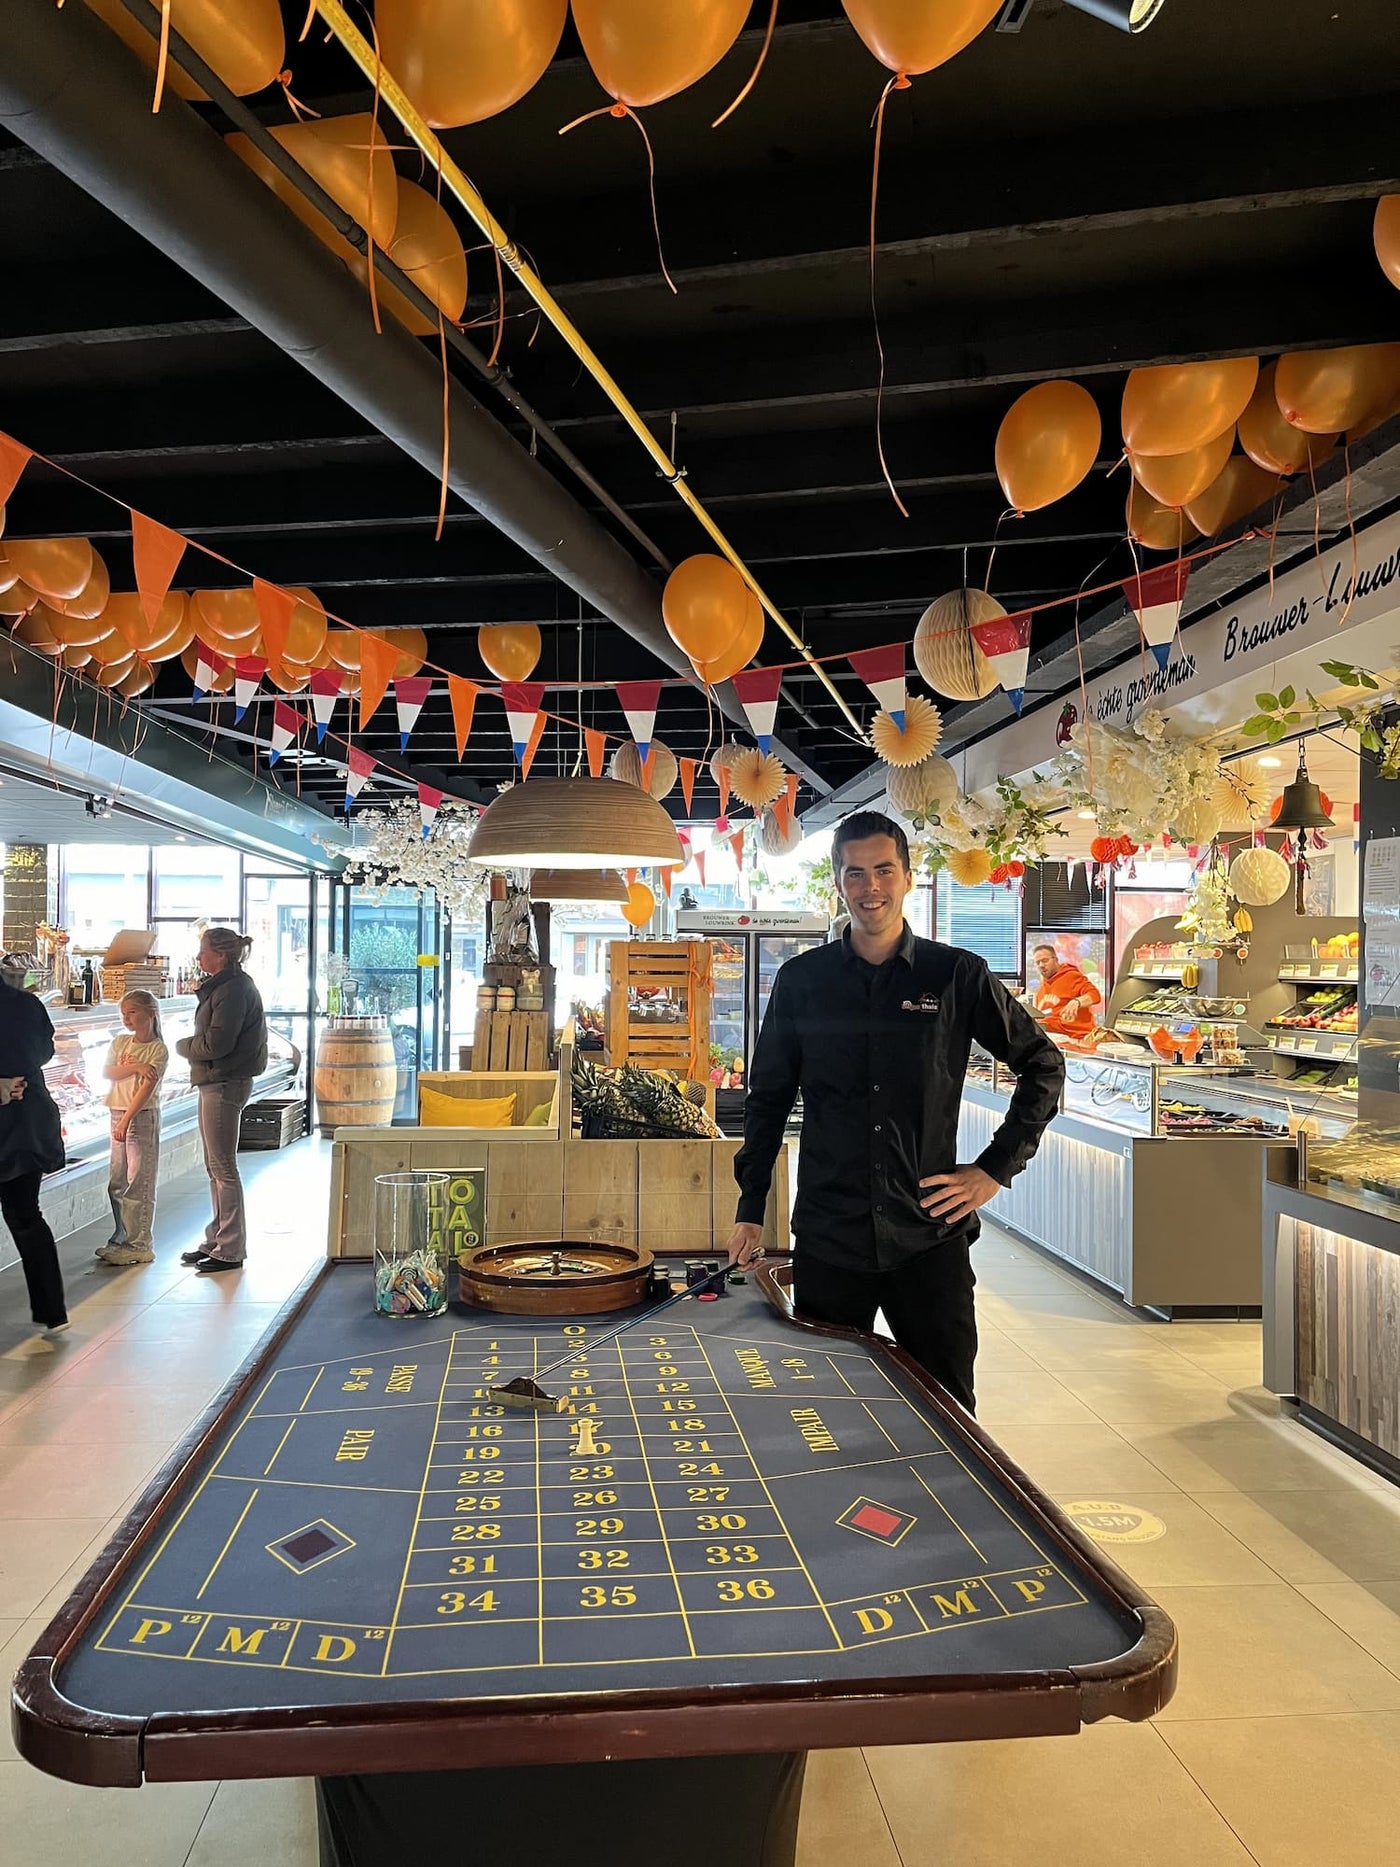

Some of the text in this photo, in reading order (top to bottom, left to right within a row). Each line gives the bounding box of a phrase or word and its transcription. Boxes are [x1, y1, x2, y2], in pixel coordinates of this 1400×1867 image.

[563, 1326, 586, 1336] 0
[488, 1341, 499, 1350] 1
[568, 1340, 586, 1348] 2
[649, 1337, 668, 1346] 3
[482, 1356, 502, 1365] 4
[654, 1351, 673, 1360] 6
[481, 1371, 500, 1380] 7
[570, 1368, 590, 1379] 8
[658, 1366, 678, 1376] 9
[734, 1348, 777, 1389] MANQUE
[780, 1358, 816, 1380] 1-18
[341, 1367, 374, 1391] 19-36
[384, 1364, 418, 1393] PASSE
[568, 1385, 596, 1396] 11
[656, 1382, 690, 1393] 12
[469, 1406, 505, 1417] 13
[567, 1403, 601, 1414] 14
[661, 1399, 697, 1412] 15
[466, 1425, 503, 1438] 16
[667, 1418, 707, 1432] 18
[790, 1407, 840, 1454] IMPAIR
[334, 1429, 375, 1461] PAIR
[463, 1446, 501, 1460] 19
[672, 1439, 714, 1453] 21
[457, 1469, 505, 1485] 22
[569, 1465, 615, 1481] 23
[677, 1462, 724, 1477] 24
[572, 1490, 618, 1508] 26
[686, 1486, 730, 1502] 27
[455, 1495, 501, 1512] 25
[575, 1518, 625, 1536] 29
[695, 1514, 747, 1531] 30
[450, 1523, 501, 1541] 28
[577, 1549, 631, 1569] 32
[704, 1544, 760, 1565] 33
[448, 1554, 499, 1575] 31
[579, 1585, 638, 1608] 35
[716, 1578, 776, 1602] 36
[436, 1589, 501, 1615] 34
